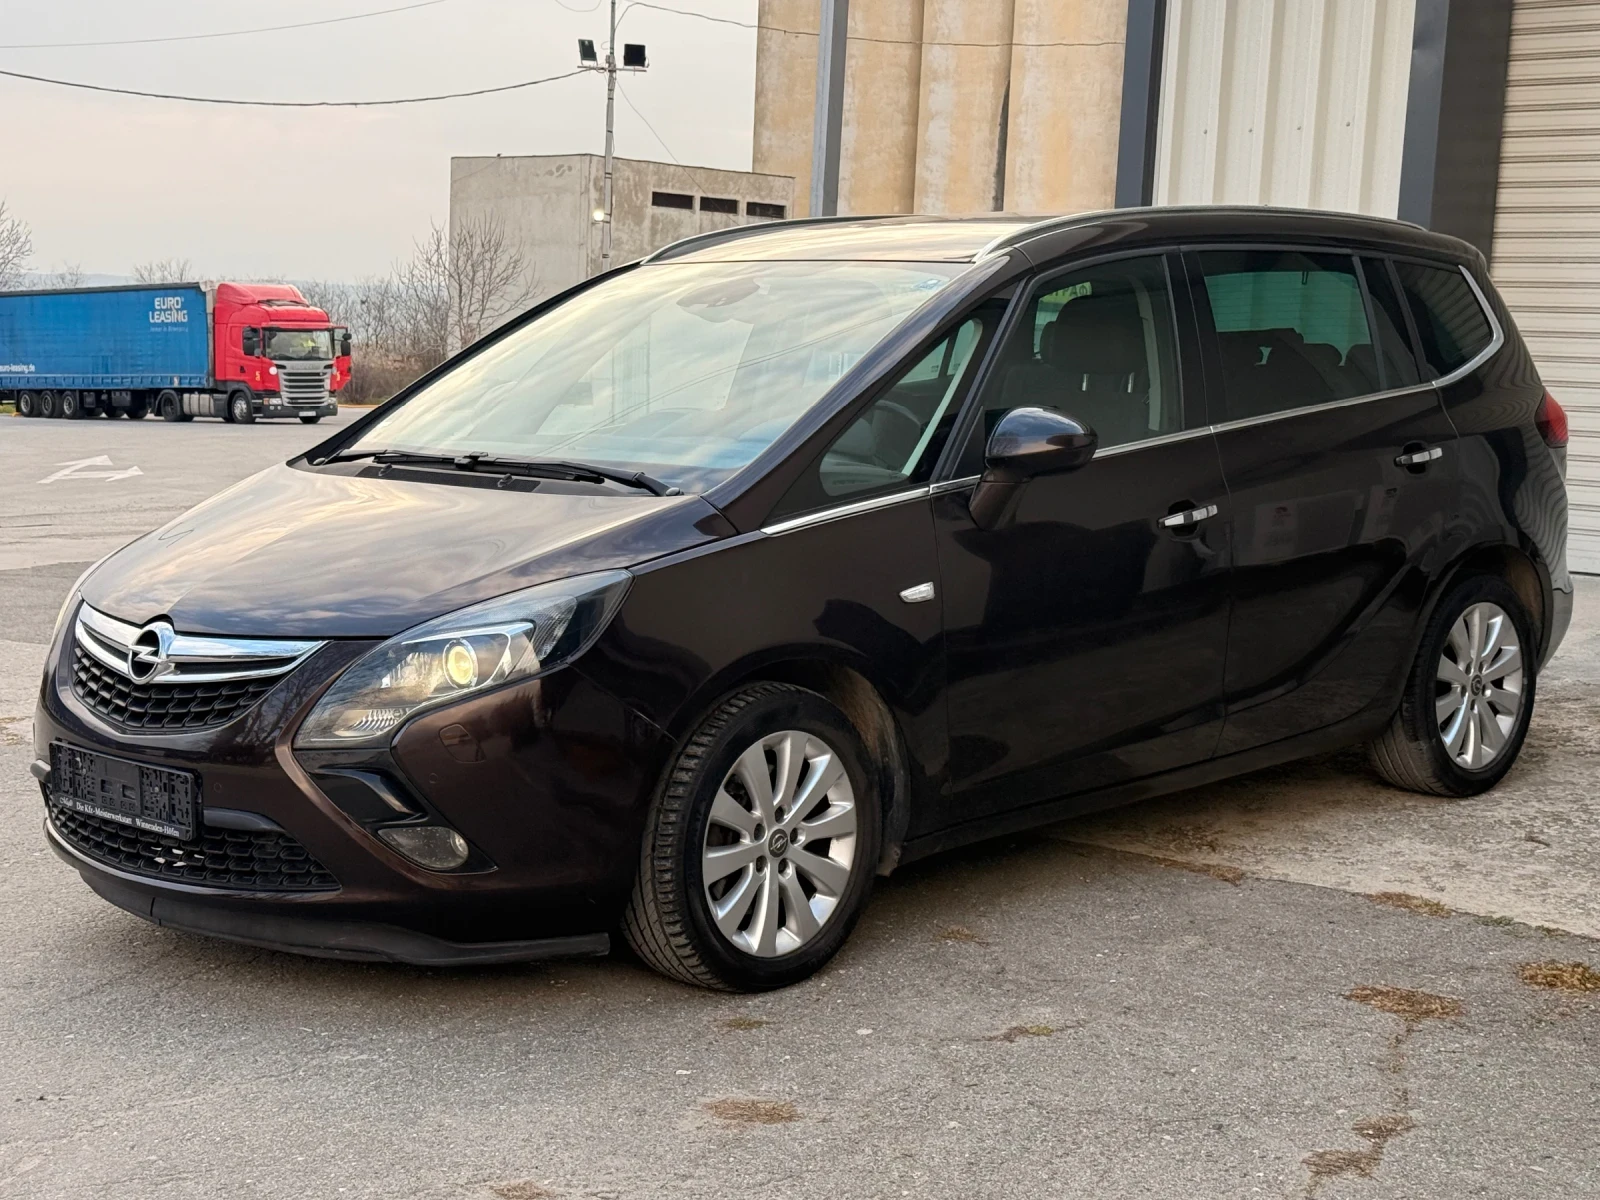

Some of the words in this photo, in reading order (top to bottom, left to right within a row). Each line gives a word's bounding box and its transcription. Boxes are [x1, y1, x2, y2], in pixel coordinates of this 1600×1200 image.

[154, 296, 182, 310] EURO
[149, 310, 188, 323] LEASING
[76, 801, 85, 811] Die
[85, 804, 133, 825] Kfz-Meisterwerkstatt
